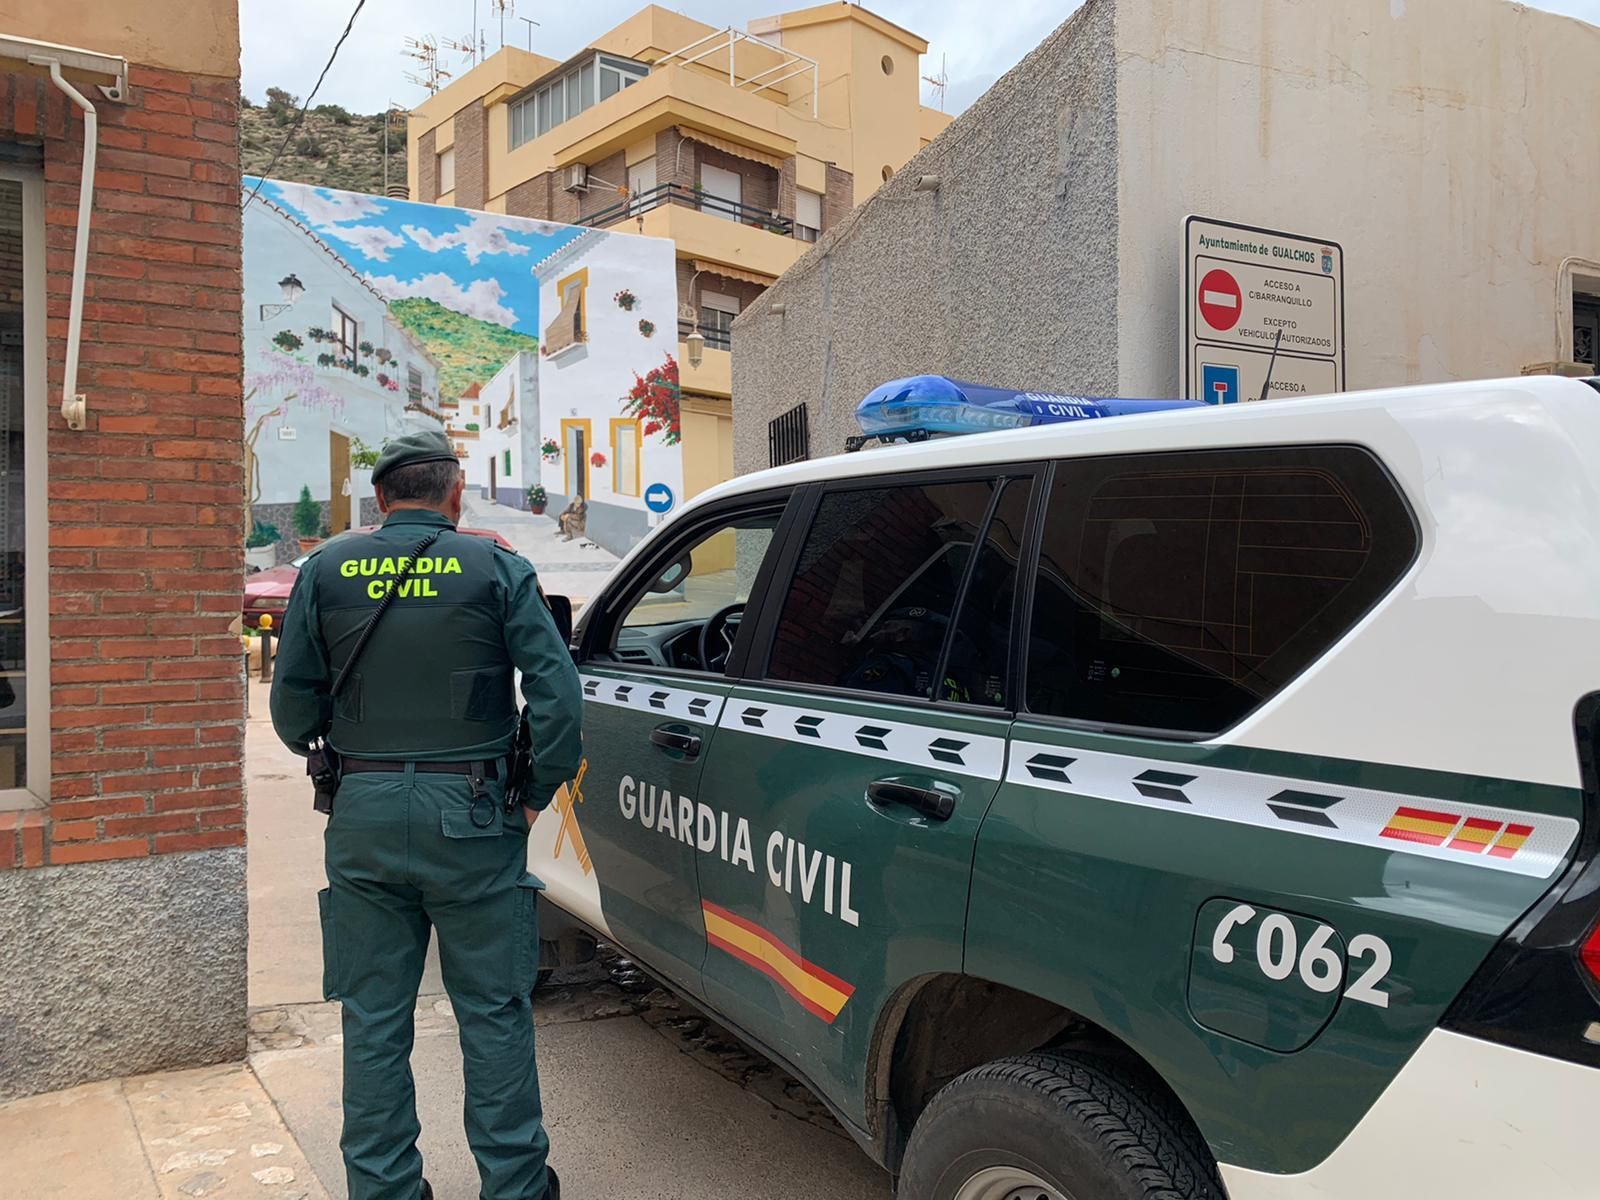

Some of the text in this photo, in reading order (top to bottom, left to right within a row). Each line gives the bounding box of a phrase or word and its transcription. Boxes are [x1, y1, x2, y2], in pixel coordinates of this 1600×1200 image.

[1199, 234, 1315, 264] Ayuntamiento de GUALCHOS
[1264, 279, 1301, 292] ACCESO A
[1263, 317, 1297, 329] EXCEPTO
[1281, 333, 1331, 348] AUTORIZADOS
[1269, 381, 1306, 393] ACCESO A
[1025, 392, 1094, 406] GUARDIA
[1048, 403, 1090, 418] CIVIL
[340, 557, 462, 577] GUARDIA
[618, 774, 860, 928] GUARDIA CIVIL
[1256, 913, 1392, 1009] 062
